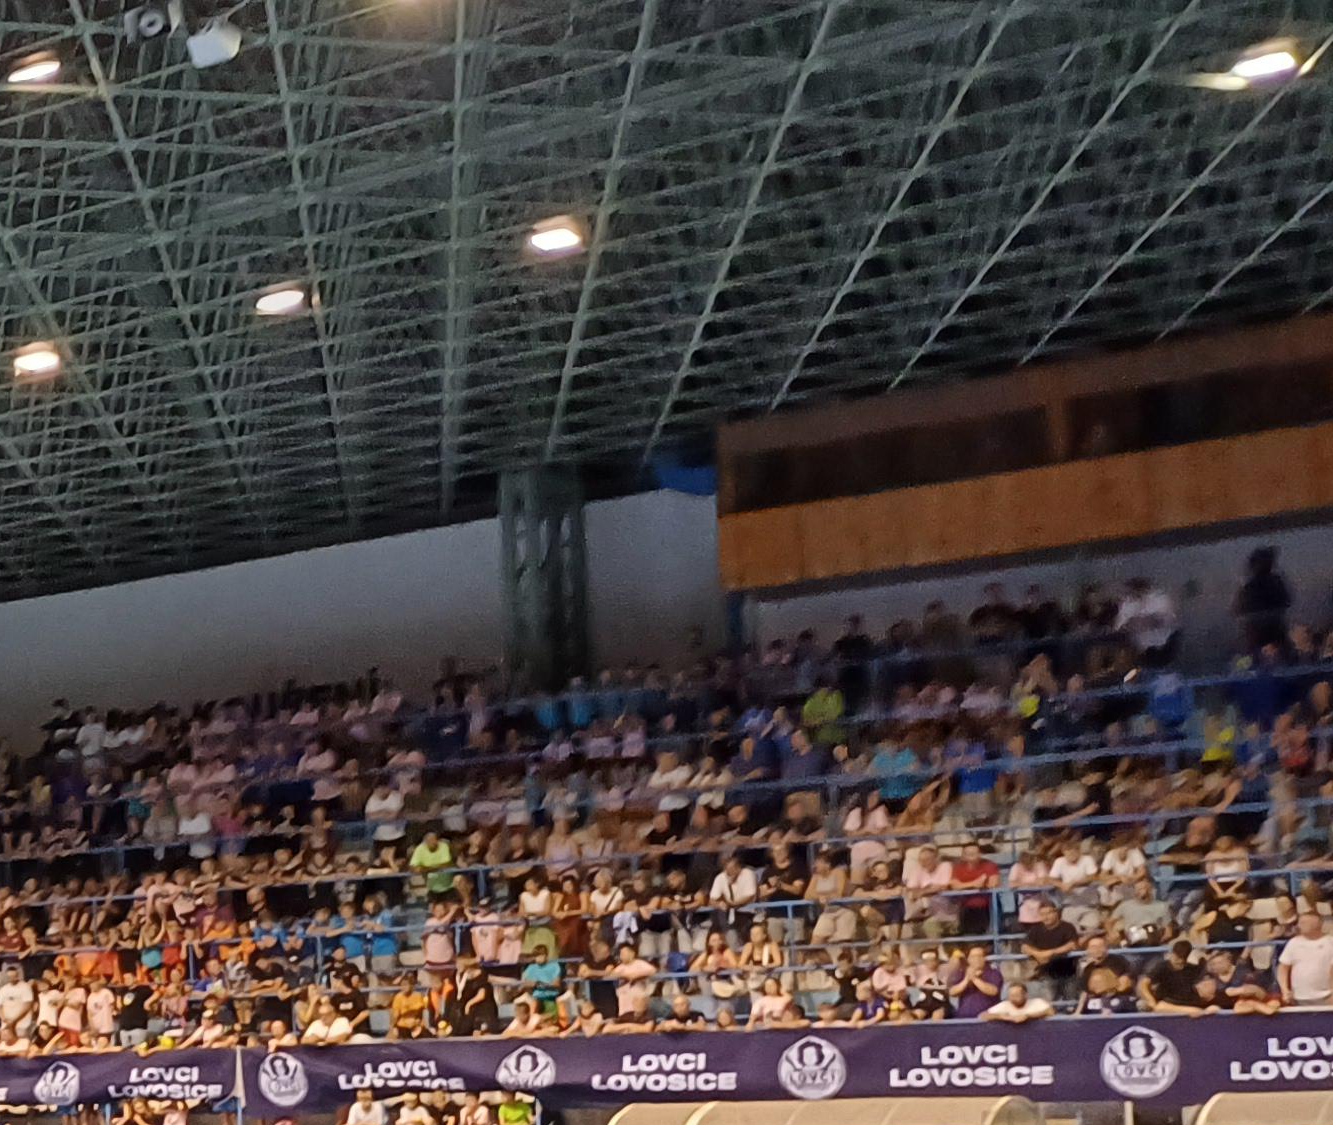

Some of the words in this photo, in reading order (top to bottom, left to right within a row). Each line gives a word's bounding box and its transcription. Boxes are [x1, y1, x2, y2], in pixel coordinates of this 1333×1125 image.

[921, 1044, 1018, 1065] LOVCI
[1267, 1037, 1333, 1058] LOV
[364, 1060, 438, 1079] LOVCI
[622, 1053, 706, 1072] LOVCI
[1230, 1061, 1333, 1081] LOVO
[129, 1067, 199, 1083] LOVCI
[591, 1072, 737, 1092] LOVOSICE
[889, 1065, 1054, 1088] LOVOSICE
[108, 1083, 223, 1100] LOVOSICE
